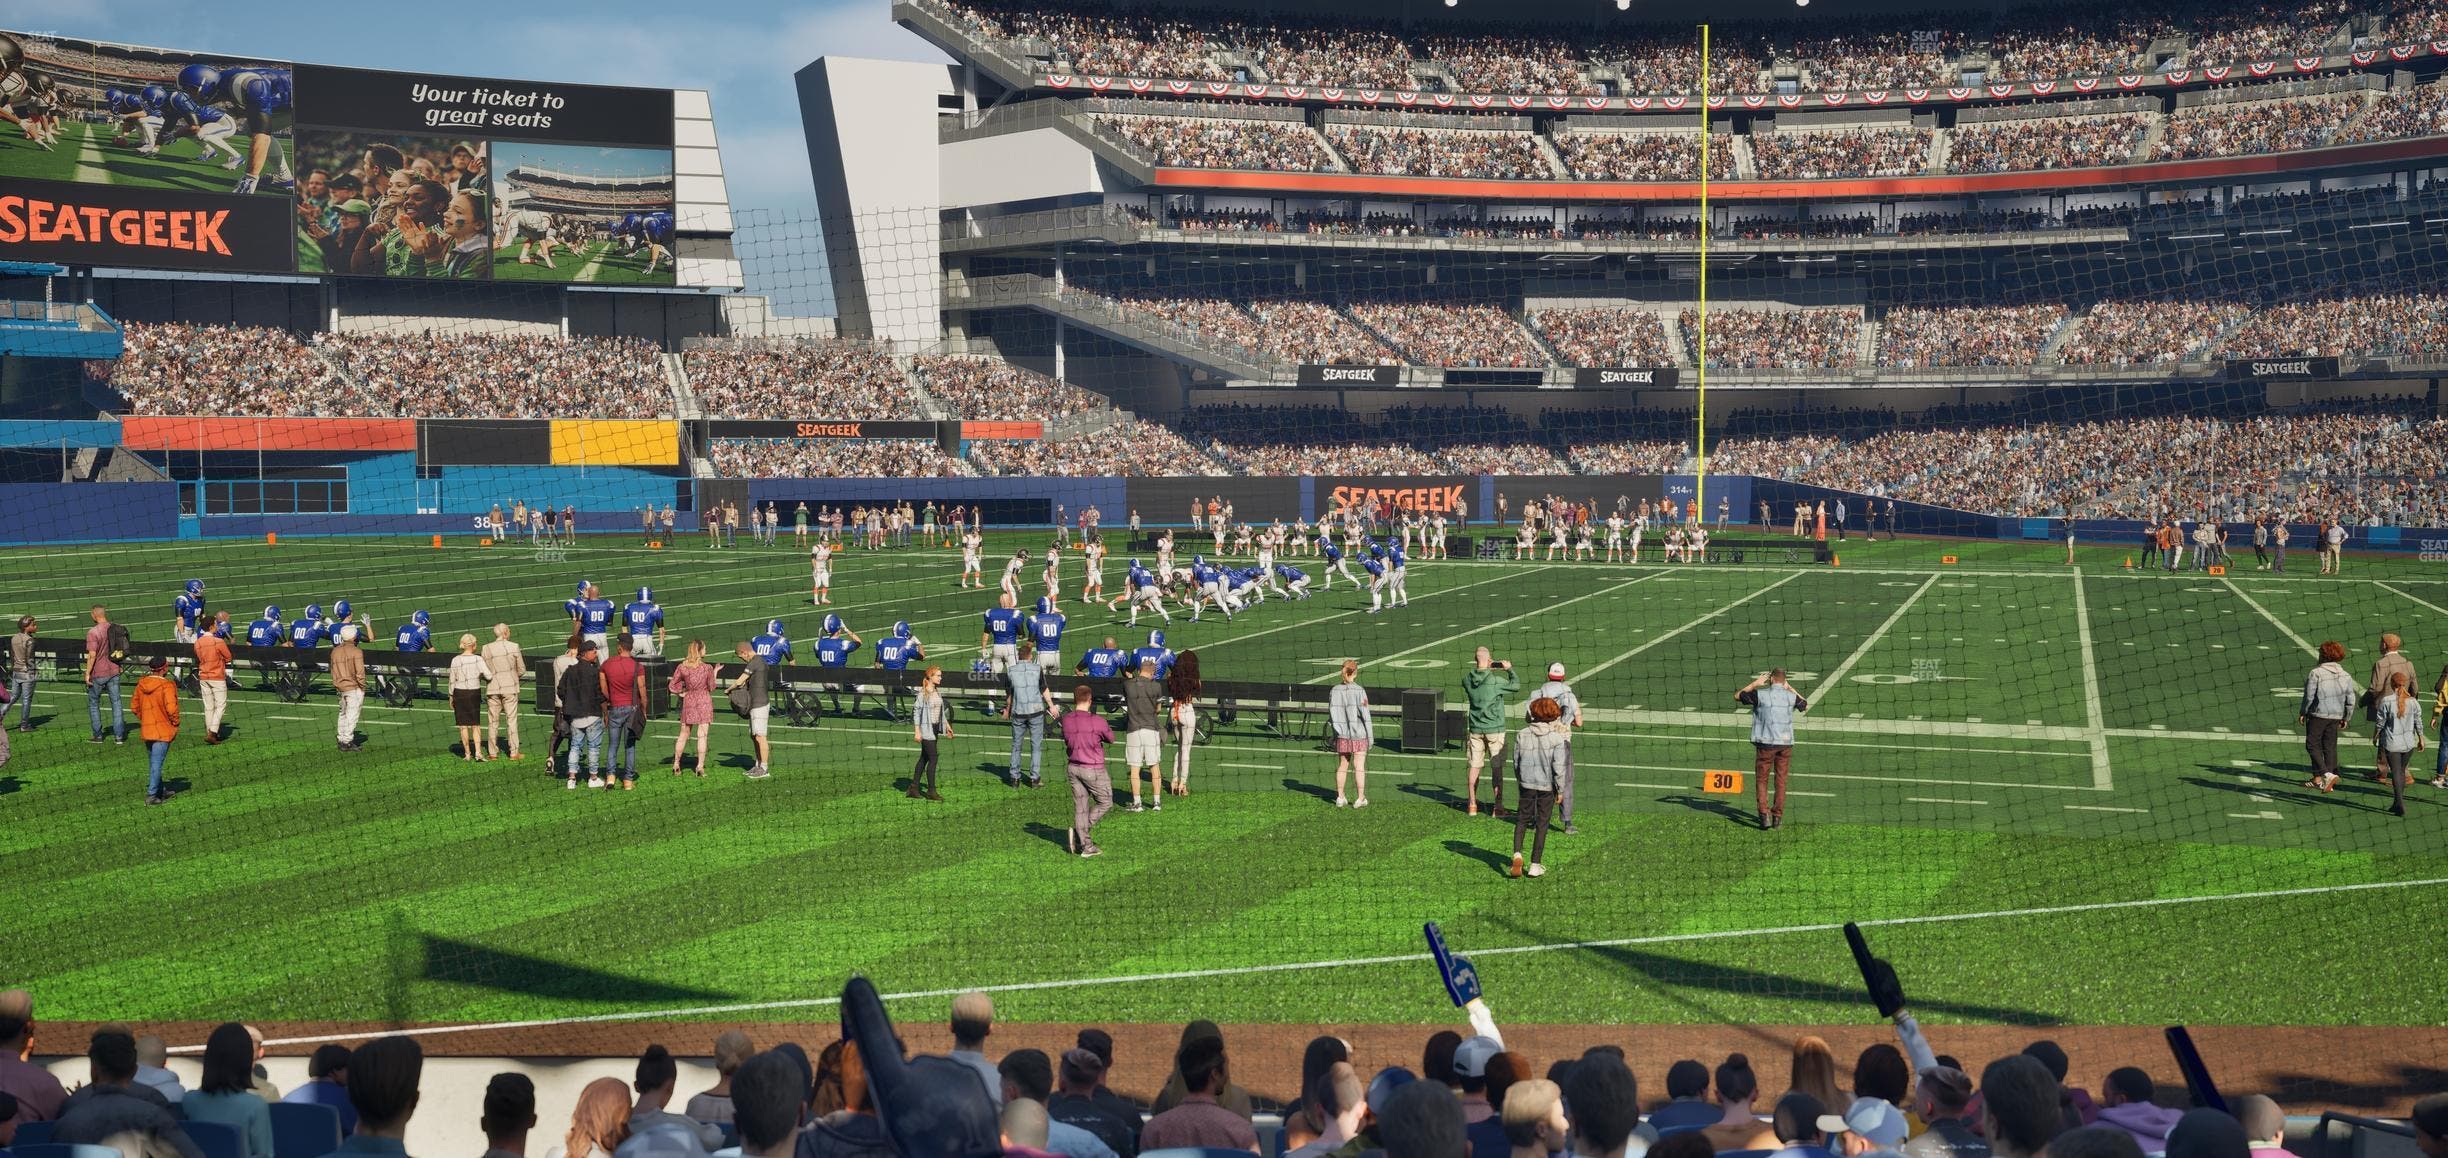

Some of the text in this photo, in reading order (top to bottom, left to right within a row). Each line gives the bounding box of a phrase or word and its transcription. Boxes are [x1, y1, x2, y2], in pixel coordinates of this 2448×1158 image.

[411, 83, 565, 109] Your ticket to
[425, 108, 552, 128] great seats
[0, 195, 232, 256] SEATGEEK
[2252, 361, 2311, 375] SEATGEEK
[1322, 368, 1376, 381] SEATGEEK
[1600, 370, 1653, 383] SEATGEEK
[796, 423, 862, 437] SEATGEEK
[632, 611, 645, 622] 00
[993, 620, 1006, 632] 00
[1042, 623, 1057, 637] 00
[252, 627, 264, 638] 00
[294, 627, 306, 639] 00
[399, 632, 410, 643] 00
[757, 644, 770, 655] 00
[883, 647, 897, 659] 00
[821, 650, 835, 662] 00
[1092, 653, 1108, 664] 00
[1713, 774, 1733, 788] 30
